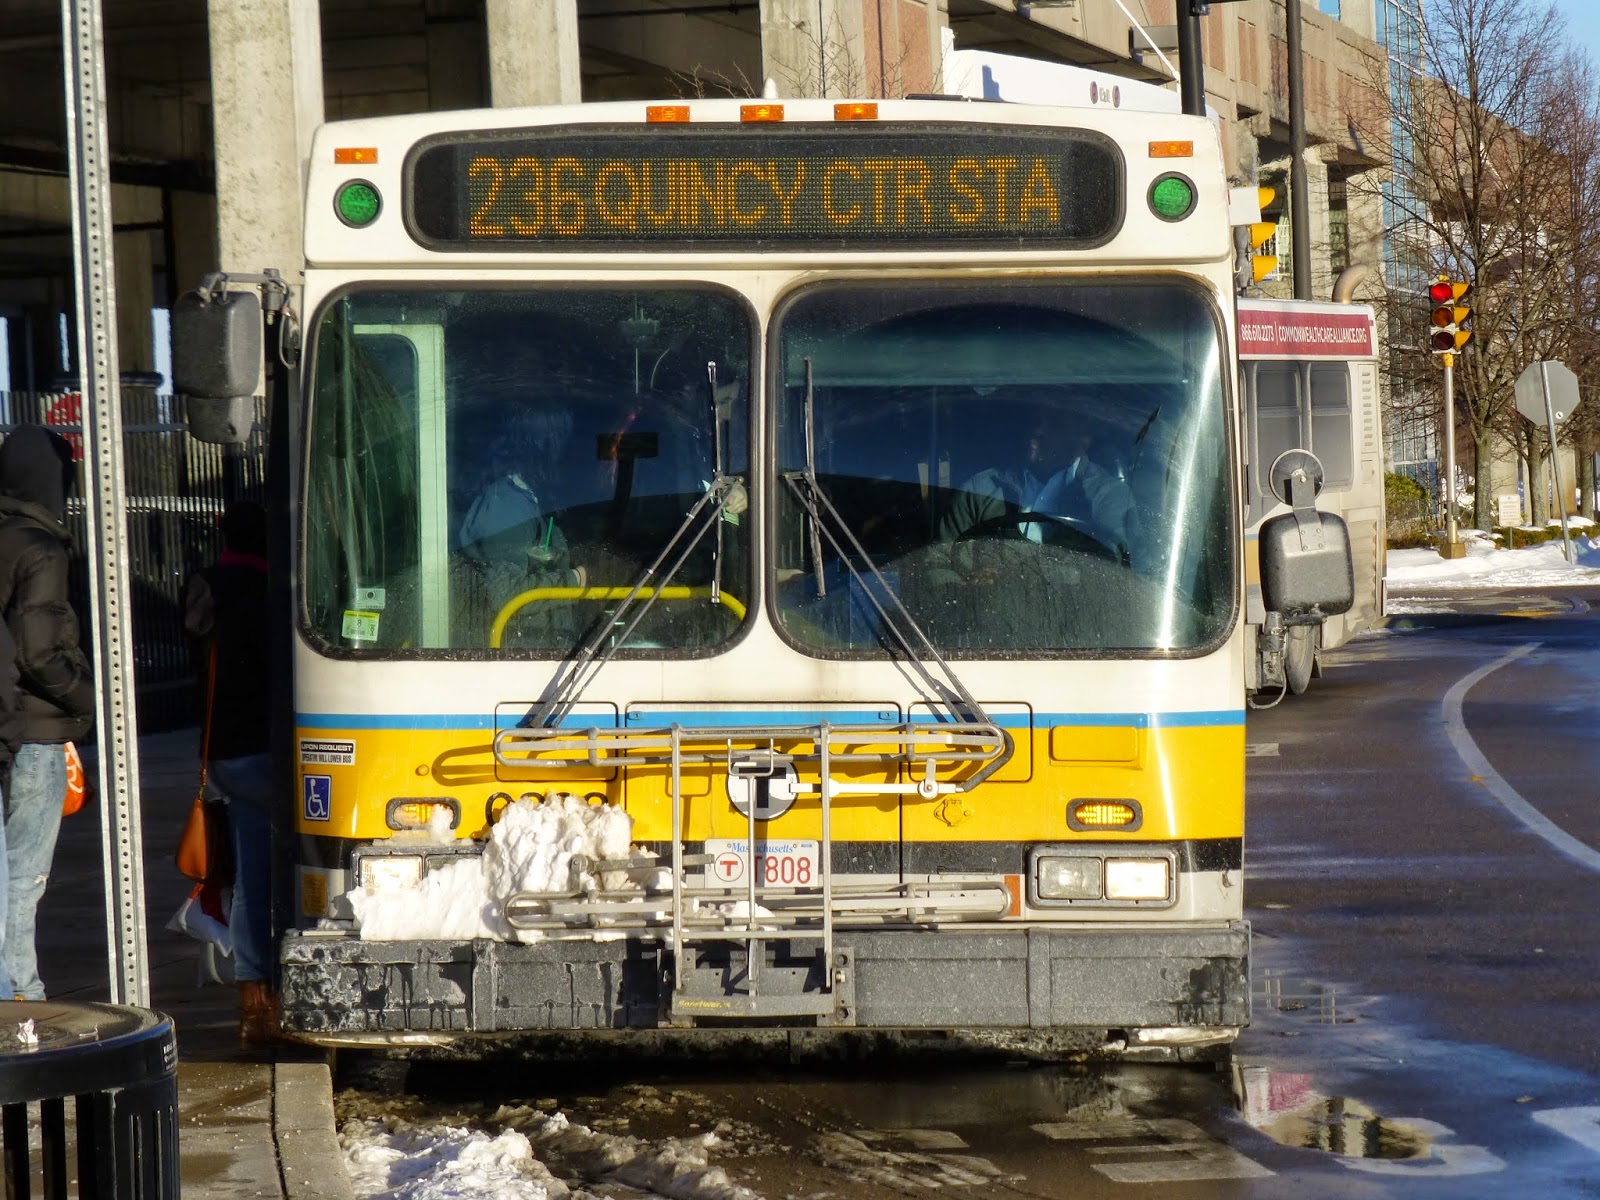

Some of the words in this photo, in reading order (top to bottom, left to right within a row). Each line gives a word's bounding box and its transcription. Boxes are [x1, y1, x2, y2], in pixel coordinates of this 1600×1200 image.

[468, 156, 586, 236] 236
[594, 160, 806, 231] QUINCY
[822, 159, 933, 225] CTR
[948, 157, 1061, 225] STA
[328, 754, 342, 763] LOWER
[342, 755, 352, 763] BUS
[738, 767, 787, 808] T
[732, 842, 793, 854] Masachusetts
[720, 861, 738, 876] T
